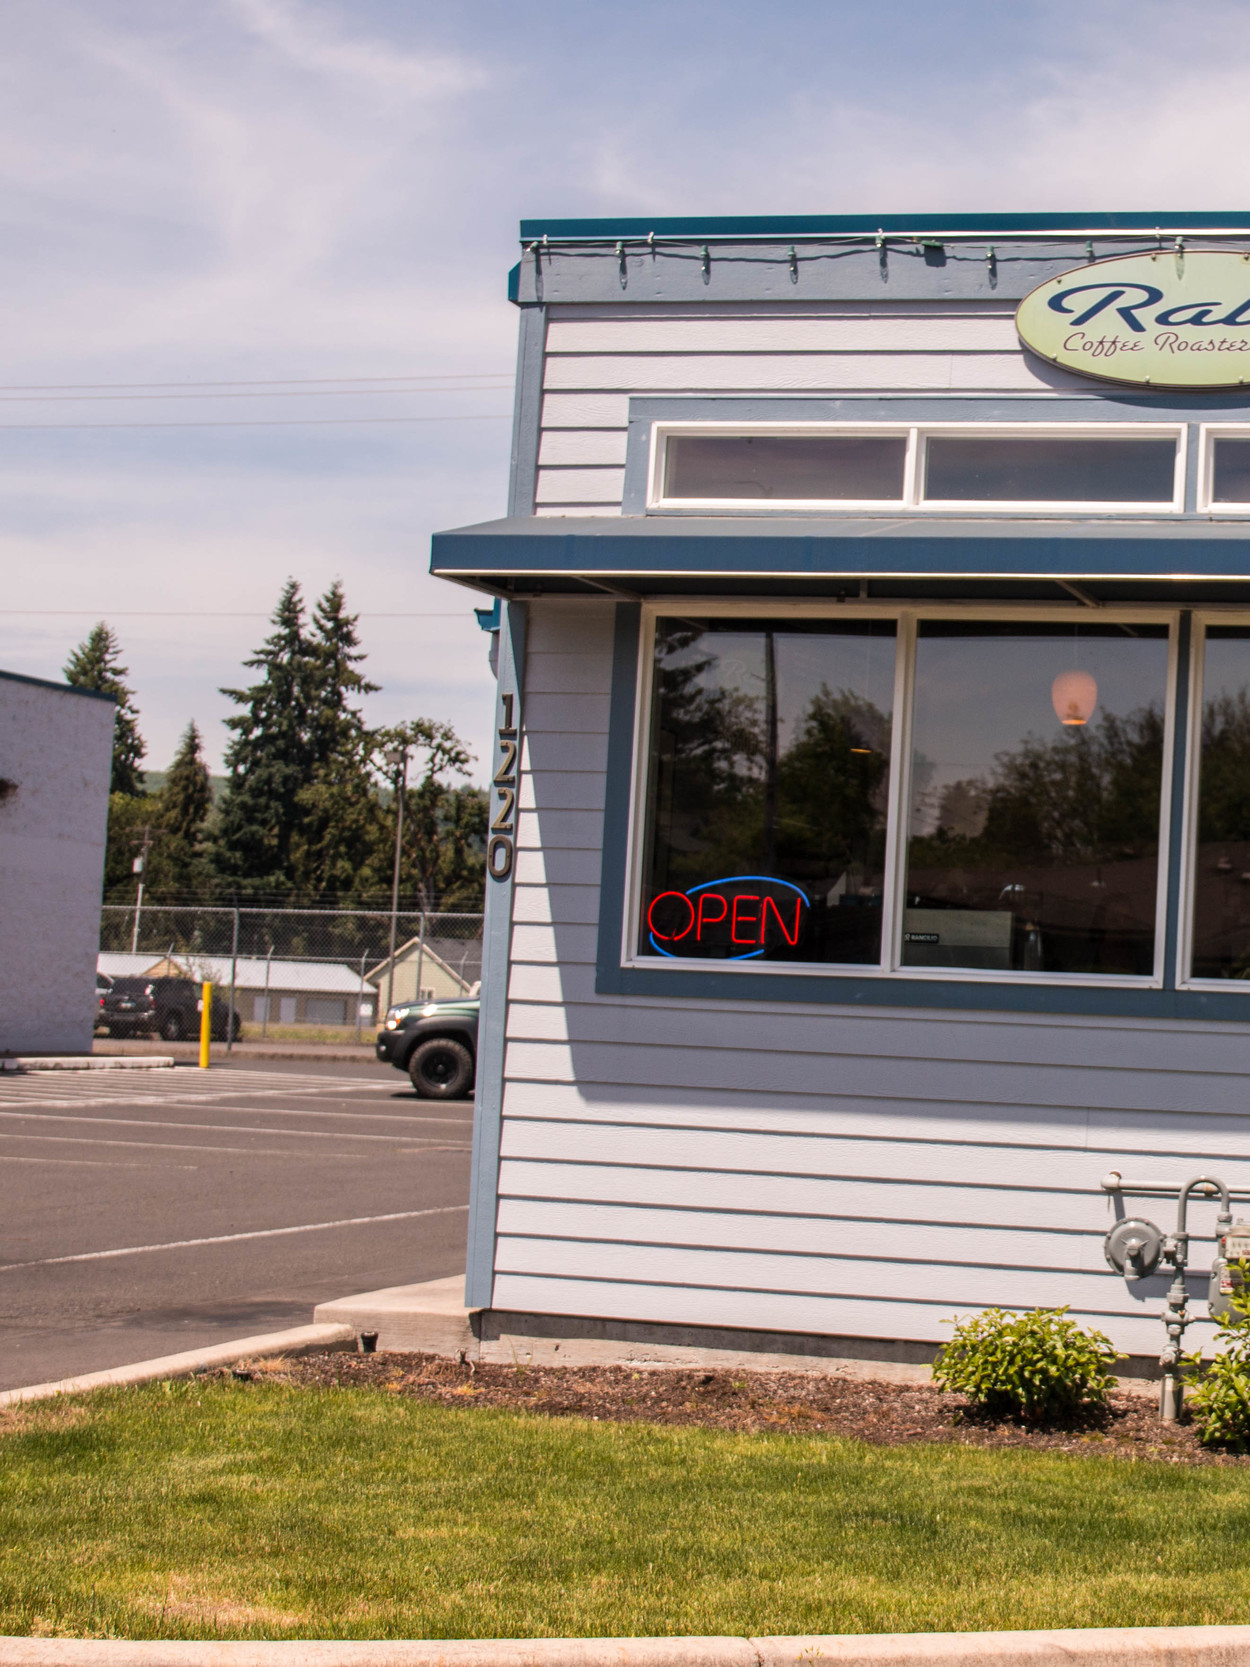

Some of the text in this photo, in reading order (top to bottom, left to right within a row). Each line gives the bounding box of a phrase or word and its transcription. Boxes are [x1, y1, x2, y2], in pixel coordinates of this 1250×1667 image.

[1063, 331, 1144, 357] Coffee
[487, 693, 518, 879] 1220
[648, 891, 802, 945] OPEN
